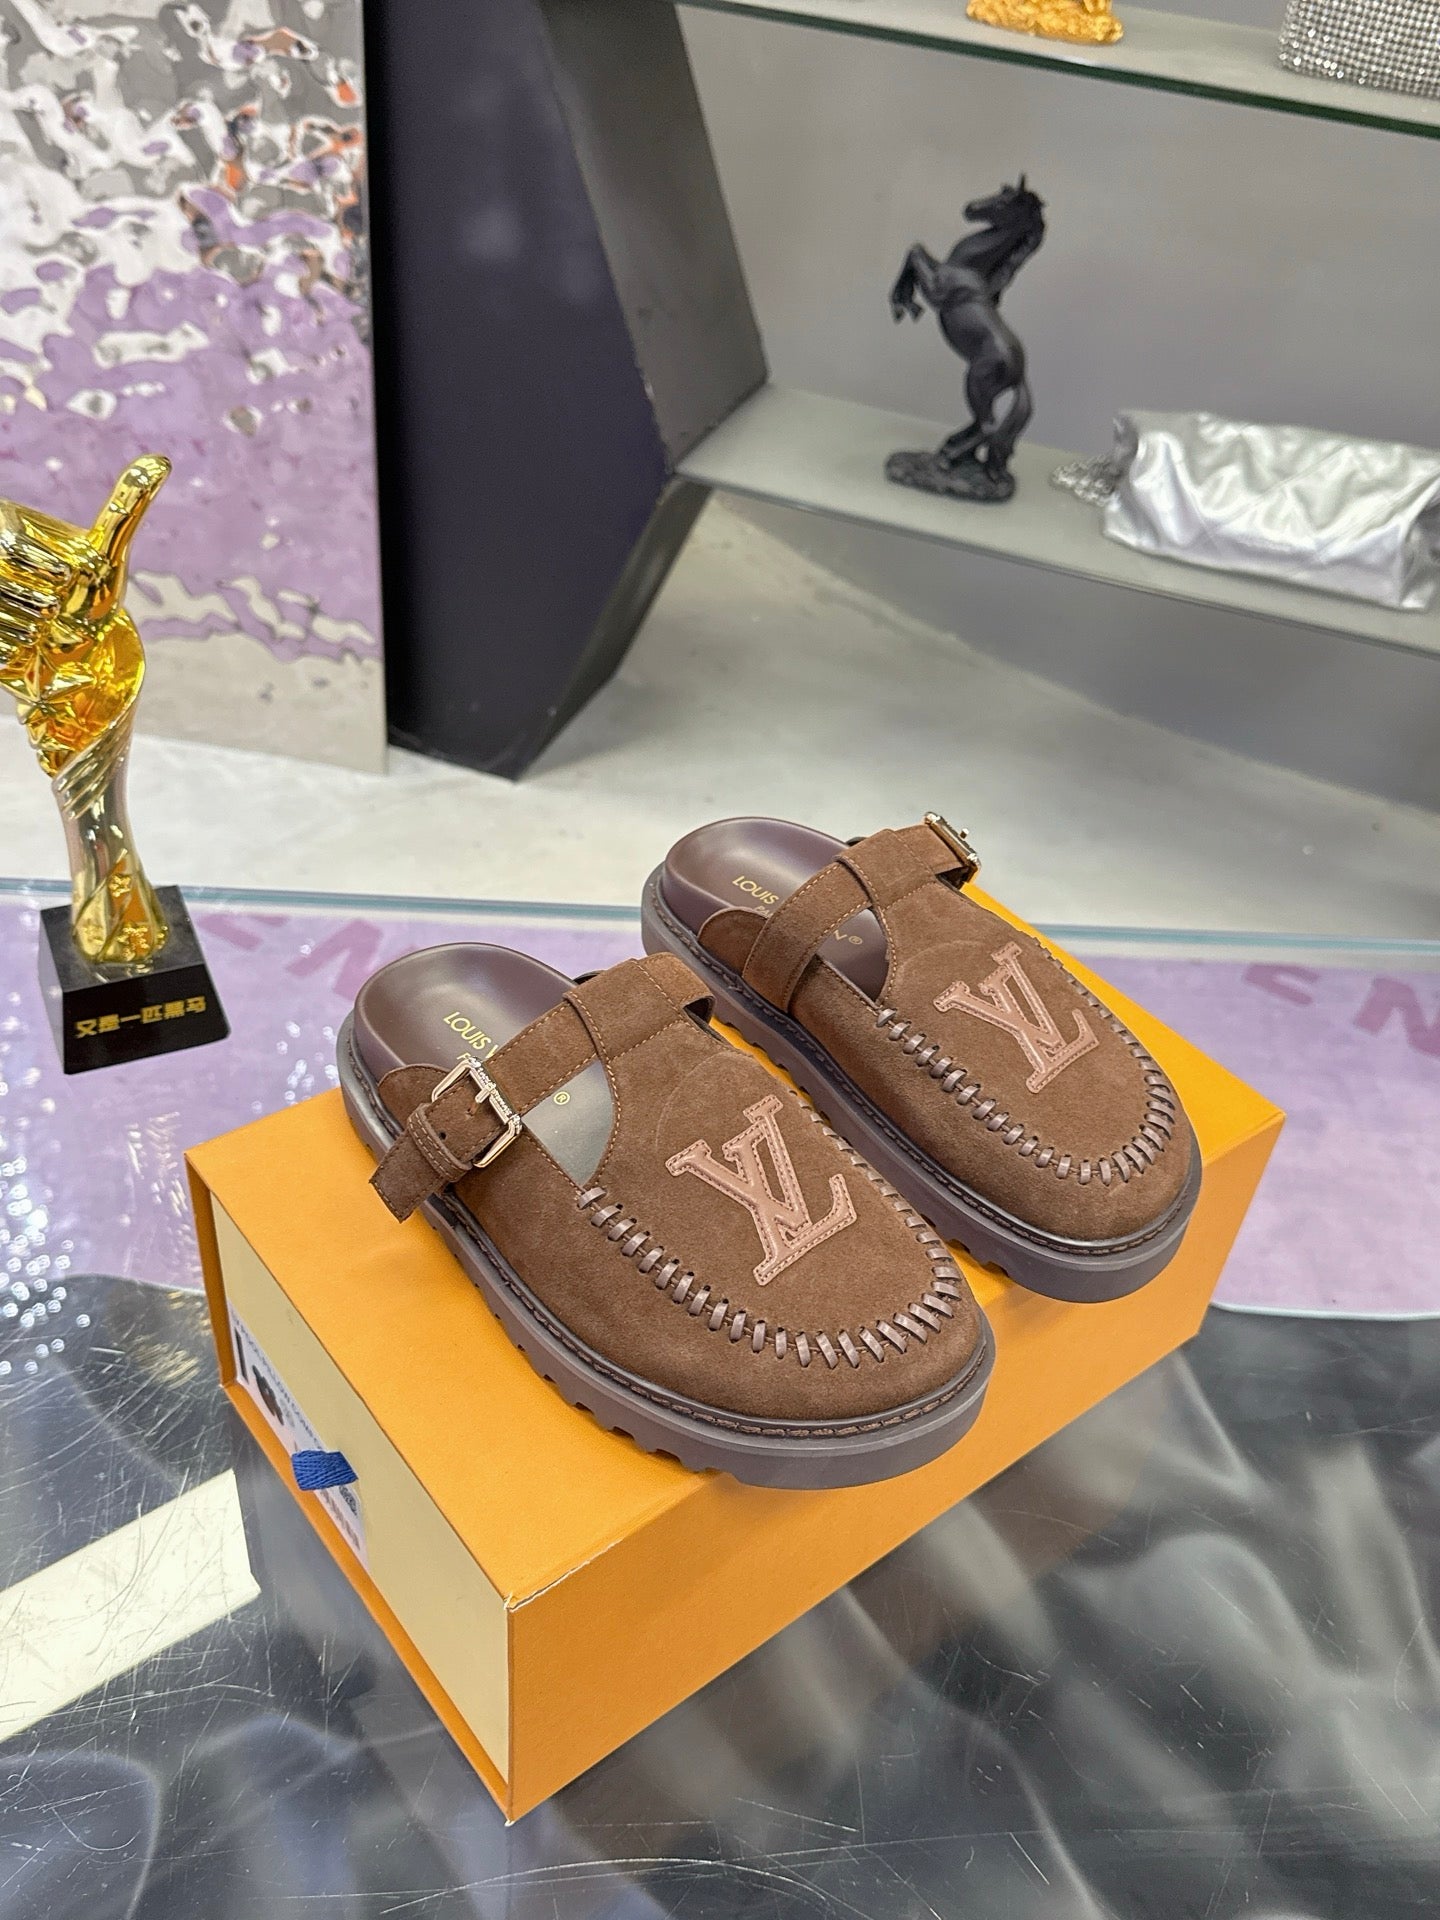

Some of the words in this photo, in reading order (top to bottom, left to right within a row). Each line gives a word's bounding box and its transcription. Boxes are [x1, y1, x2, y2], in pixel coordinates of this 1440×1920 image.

[732, 876, 780, 905] LOUIS
[443, 1011, 492, 1050] LOUIS
[933, 941, 1100, 1094] LV
[665, 1094, 858, 1286] LV
